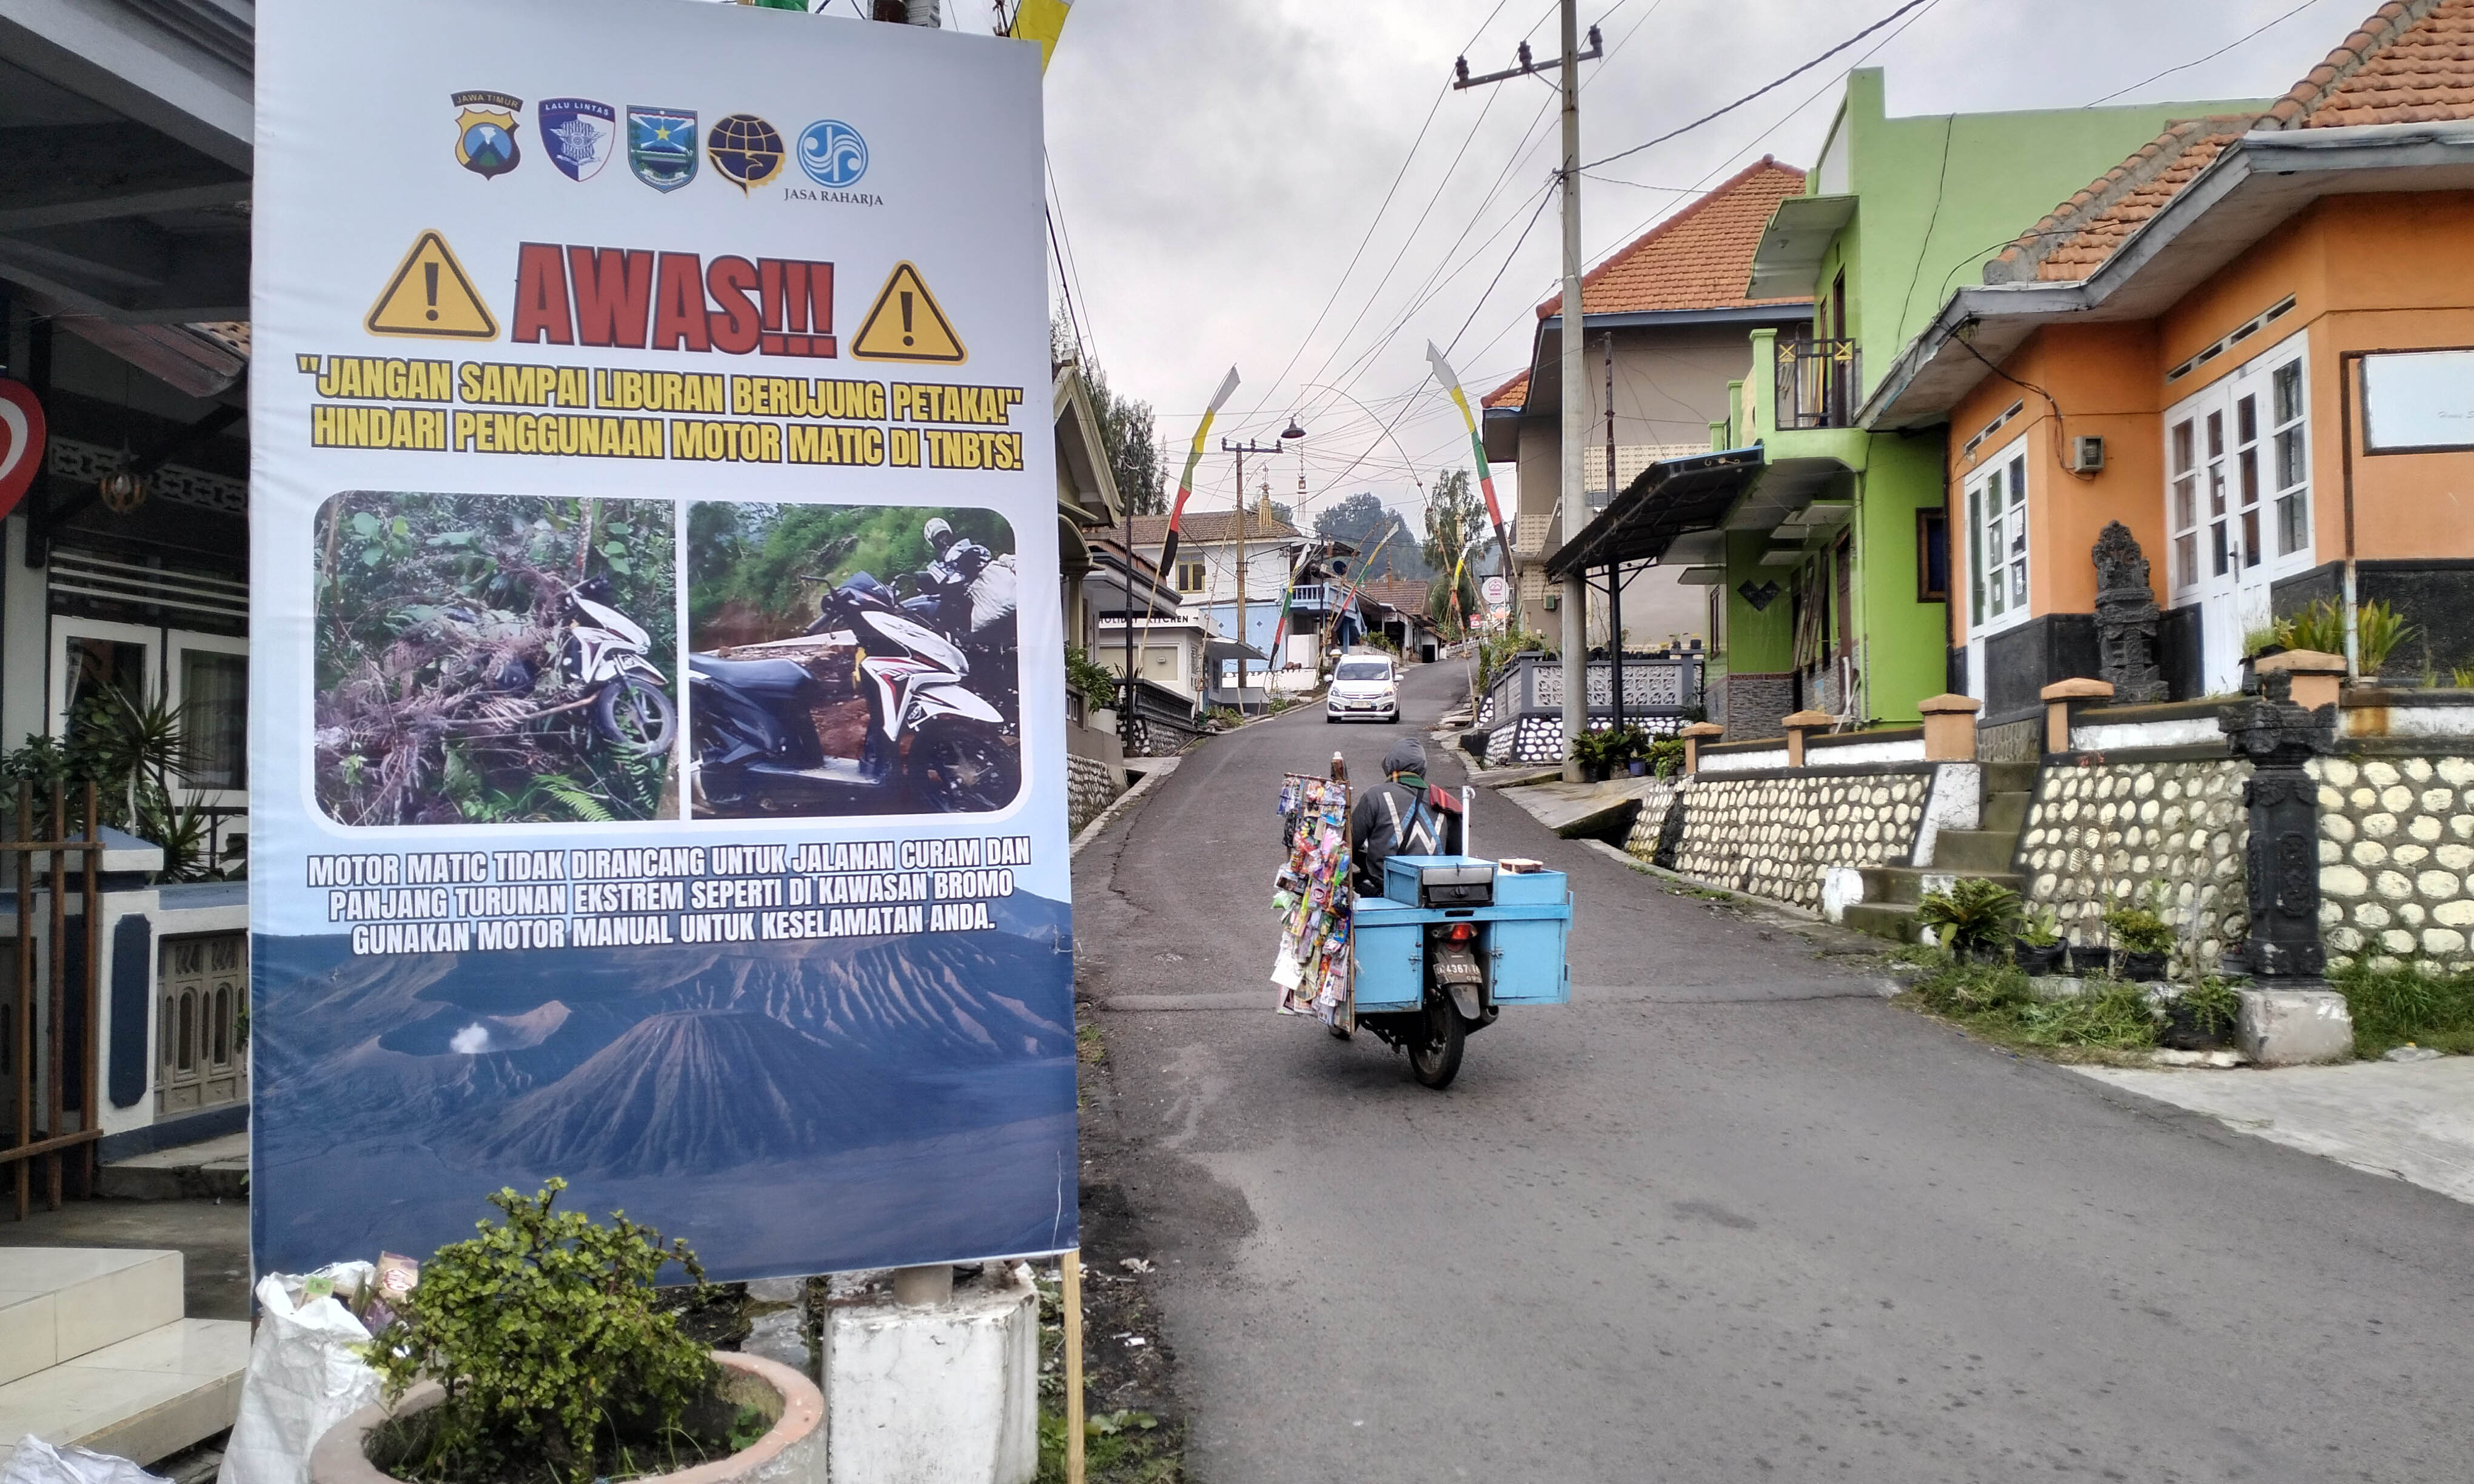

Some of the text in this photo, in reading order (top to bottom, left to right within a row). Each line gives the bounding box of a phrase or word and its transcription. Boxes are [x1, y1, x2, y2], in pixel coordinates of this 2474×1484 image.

[457, 93, 519, 109] JAWA TIMUR
[546, 102, 609, 116] LALU LINTAS
[784, 188, 883, 207] JASA RAHARJA
[511, 241, 838, 359] AWAS!!!
[296, 353, 1024, 426] "JANGAN SAMPAI LIBURAN BERUJUNG PETAKA!"
[311, 404, 1024, 471] HINDARI PENGGUNAAN MOTOR MATIC DI TNBTS!
[307, 835, 1031, 887] MOTOR MATIC TIDAK DIRANCANG UNTUK JALANAN CURAM DAN
[329, 868, 1014, 922] PANJANG TURUNAN EKSTREM SEPERTI DI KAWASAN BROMO
[350, 901, 996, 955] GUNAKAN MOTOR MANUAL UNTUK KESELAMATAN ANDA.
